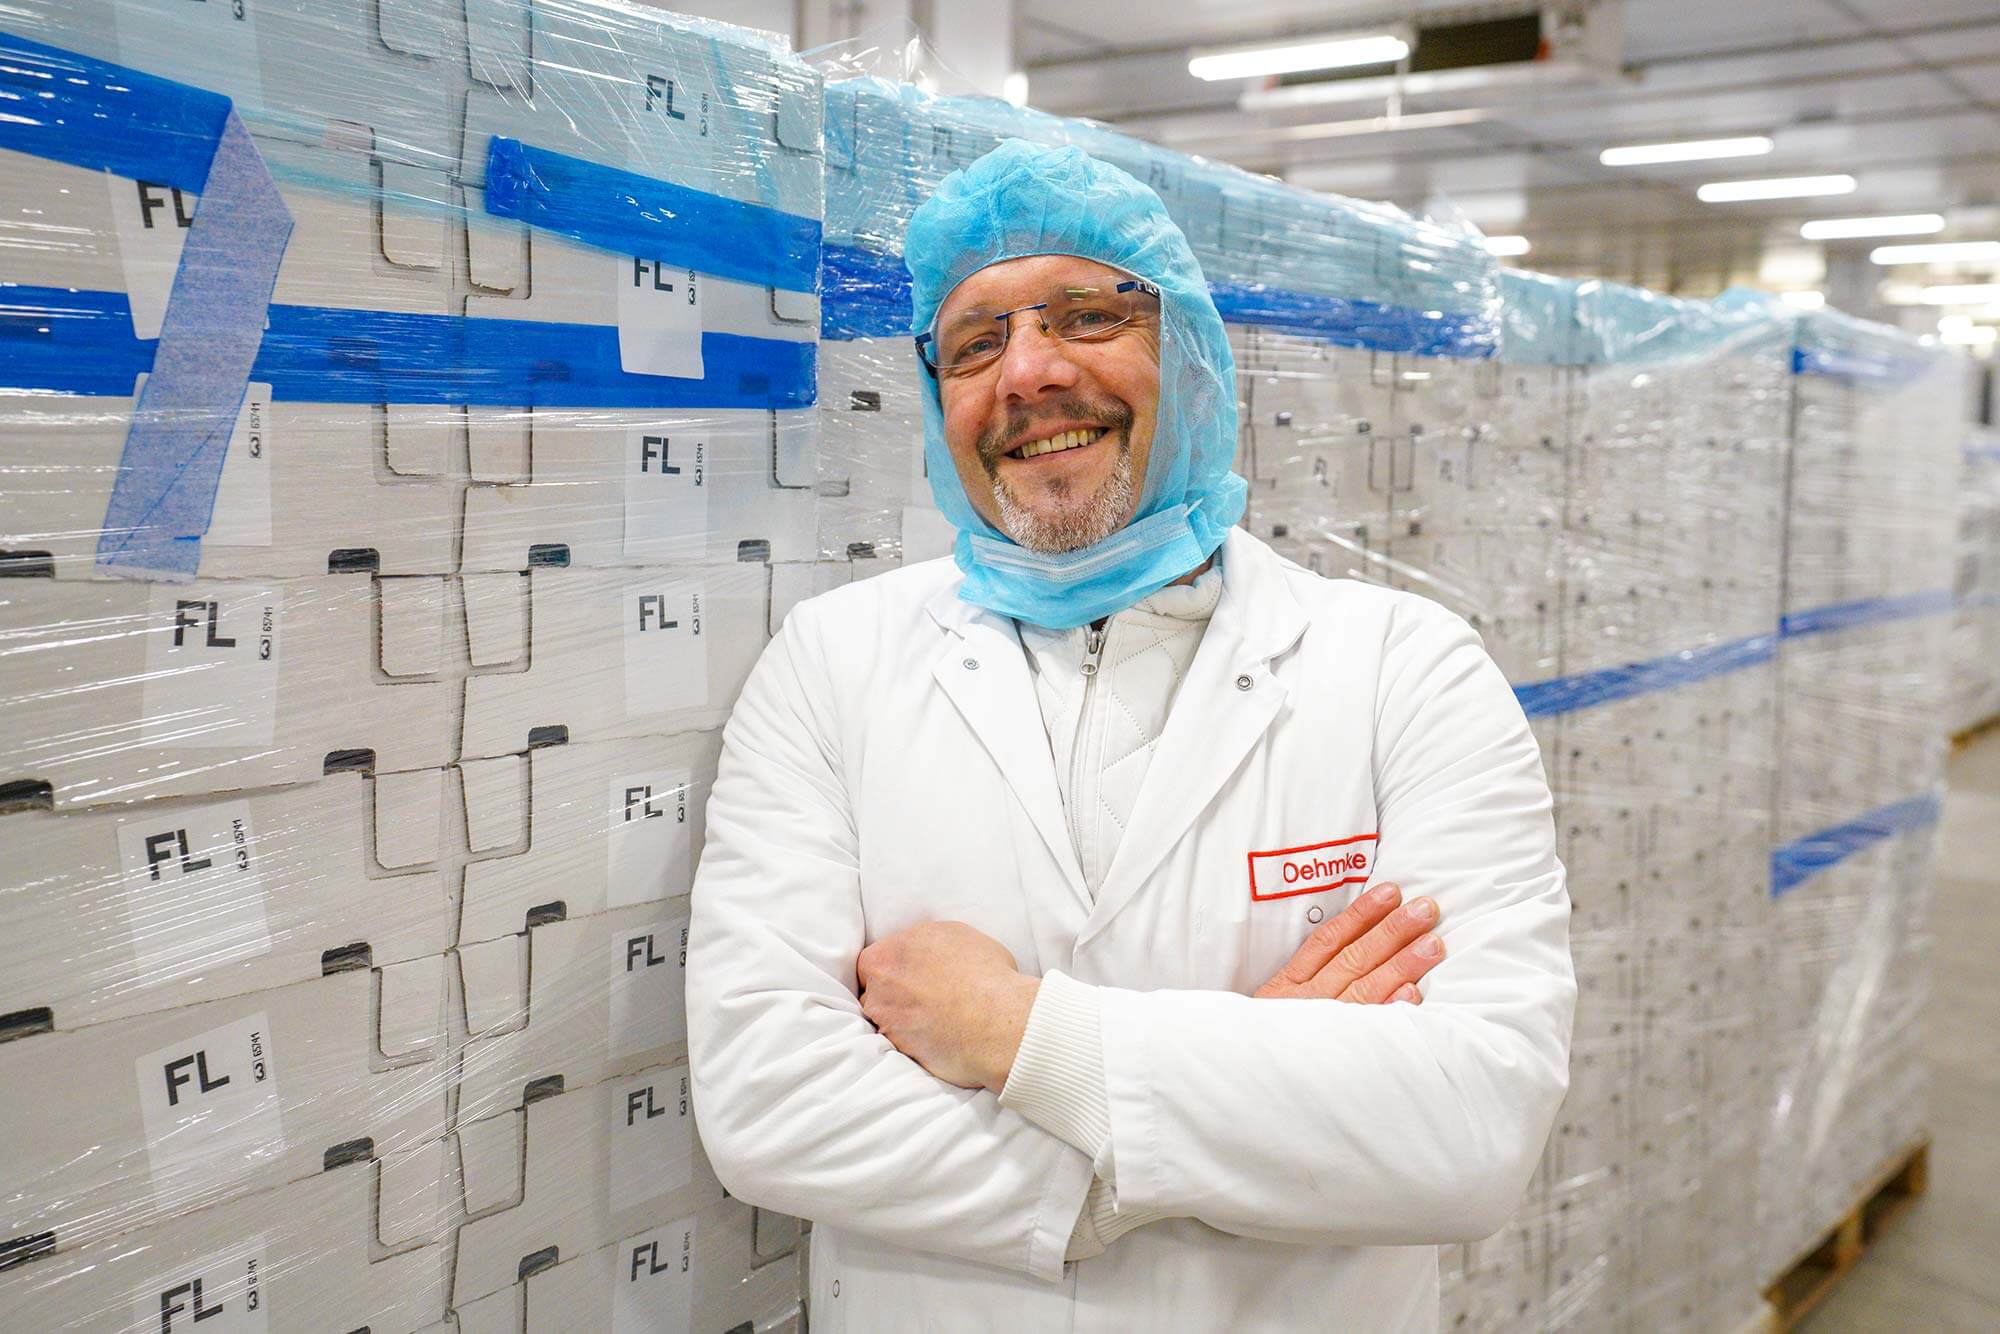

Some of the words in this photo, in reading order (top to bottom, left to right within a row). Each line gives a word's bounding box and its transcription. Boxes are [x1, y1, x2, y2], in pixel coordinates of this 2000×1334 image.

[645, 74, 685, 120] FL
[138, 180, 194, 229] FL
[634, 258, 673, 292] FL
[250, 402, 261, 430] 65741
[641, 436, 681, 475] FL
[174, 600, 236, 648] FL
[263, 606, 273, 632] 65741
[639, 595, 678, 631] FL
[624, 785, 663, 822] FL
[145, 829, 212, 881] FL
[1283, 852, 1367, 884] Oehmke
[626, 934, 665, 971] FL
[250, 1031, 262, 1057] 65741
[164, 1050, 230, 1106] FL
[627, 1086, 665, 1126] FL
[631, 1241, 668, 1282] FL
[161, 1278, 224, 1334] FL
